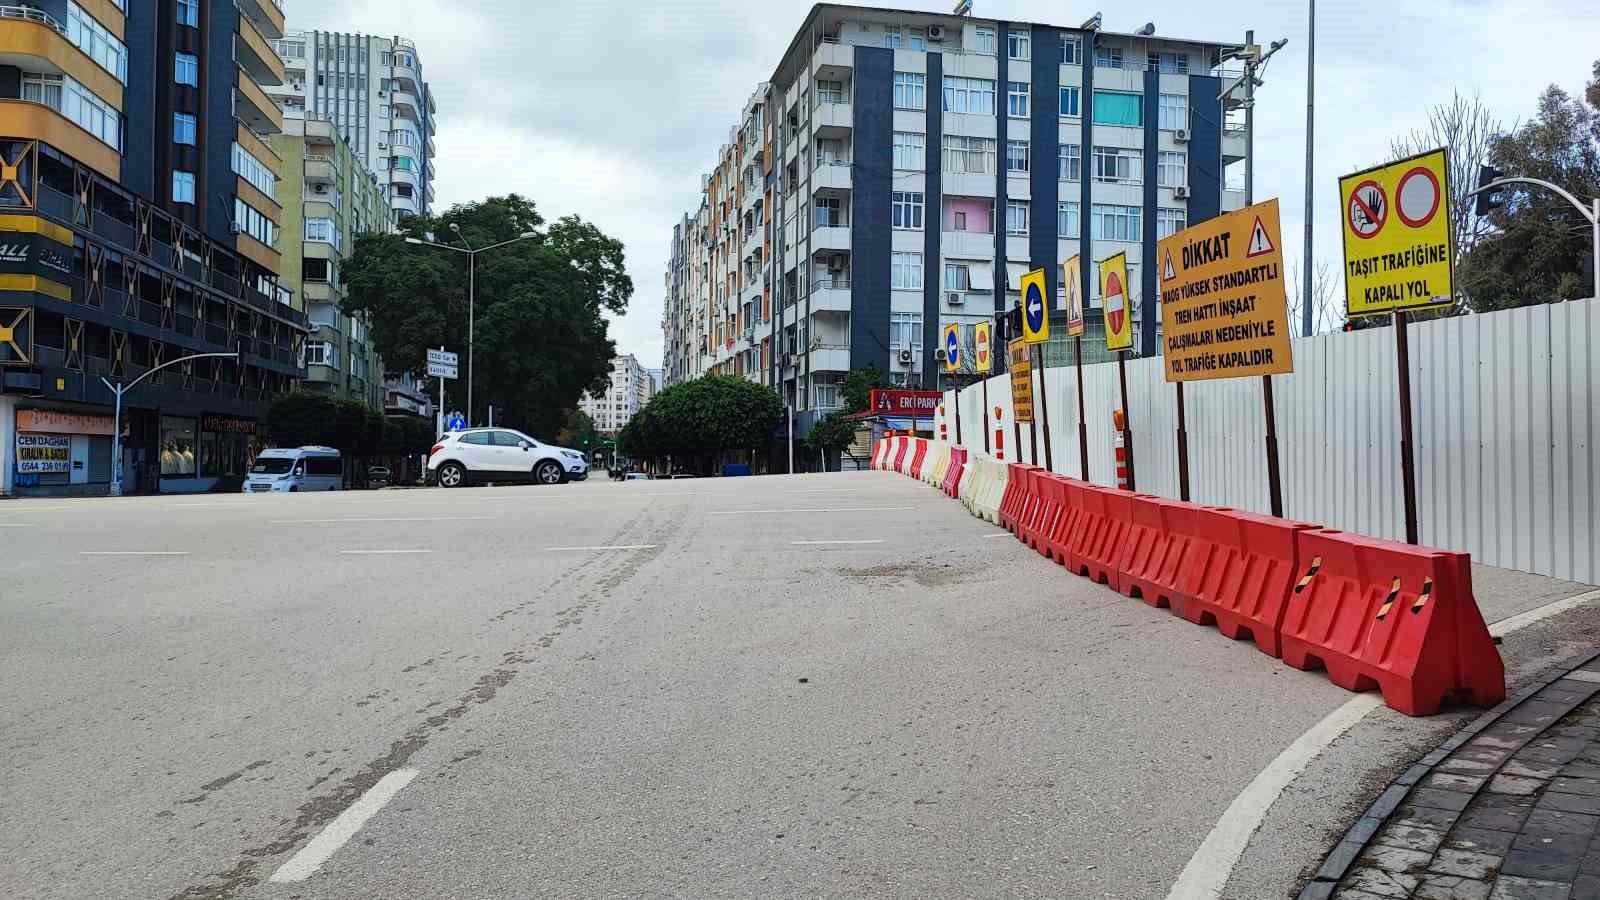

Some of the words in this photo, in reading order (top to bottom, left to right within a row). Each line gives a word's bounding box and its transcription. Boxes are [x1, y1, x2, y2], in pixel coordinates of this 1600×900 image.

[1182, 232, 1230, 270] DİKKAT
[1349, 257, 1379, 278] TAŞIT
[1381, 243, 1446, 272] TRAFİĞİNE
[1181, 278, 1211, 300] YÜKSEK
[1212, 262, 1278, 293] STANDARTLI
[1365, 283, 1404, 304] KAPALI
[1407, 280, 1431, 298] YOL
[1174, 308, 1192, 325] TREN
[1193, 303, 1217, 321] HATTI
[1220, 296, 1256, 319] İNŞAAT
[1168, 330, 1213, 353] ÇALIŞMALARI
[1216, 320, 1275, 343] NEDENİYLE
[1171, 359, 1184, 375] YOL
[1184, 352, 1216, 373] TRAFİĞE
[1218, 348, 1274, 369] KAPALIDIR
[917, 397, 936, 409] PARK
